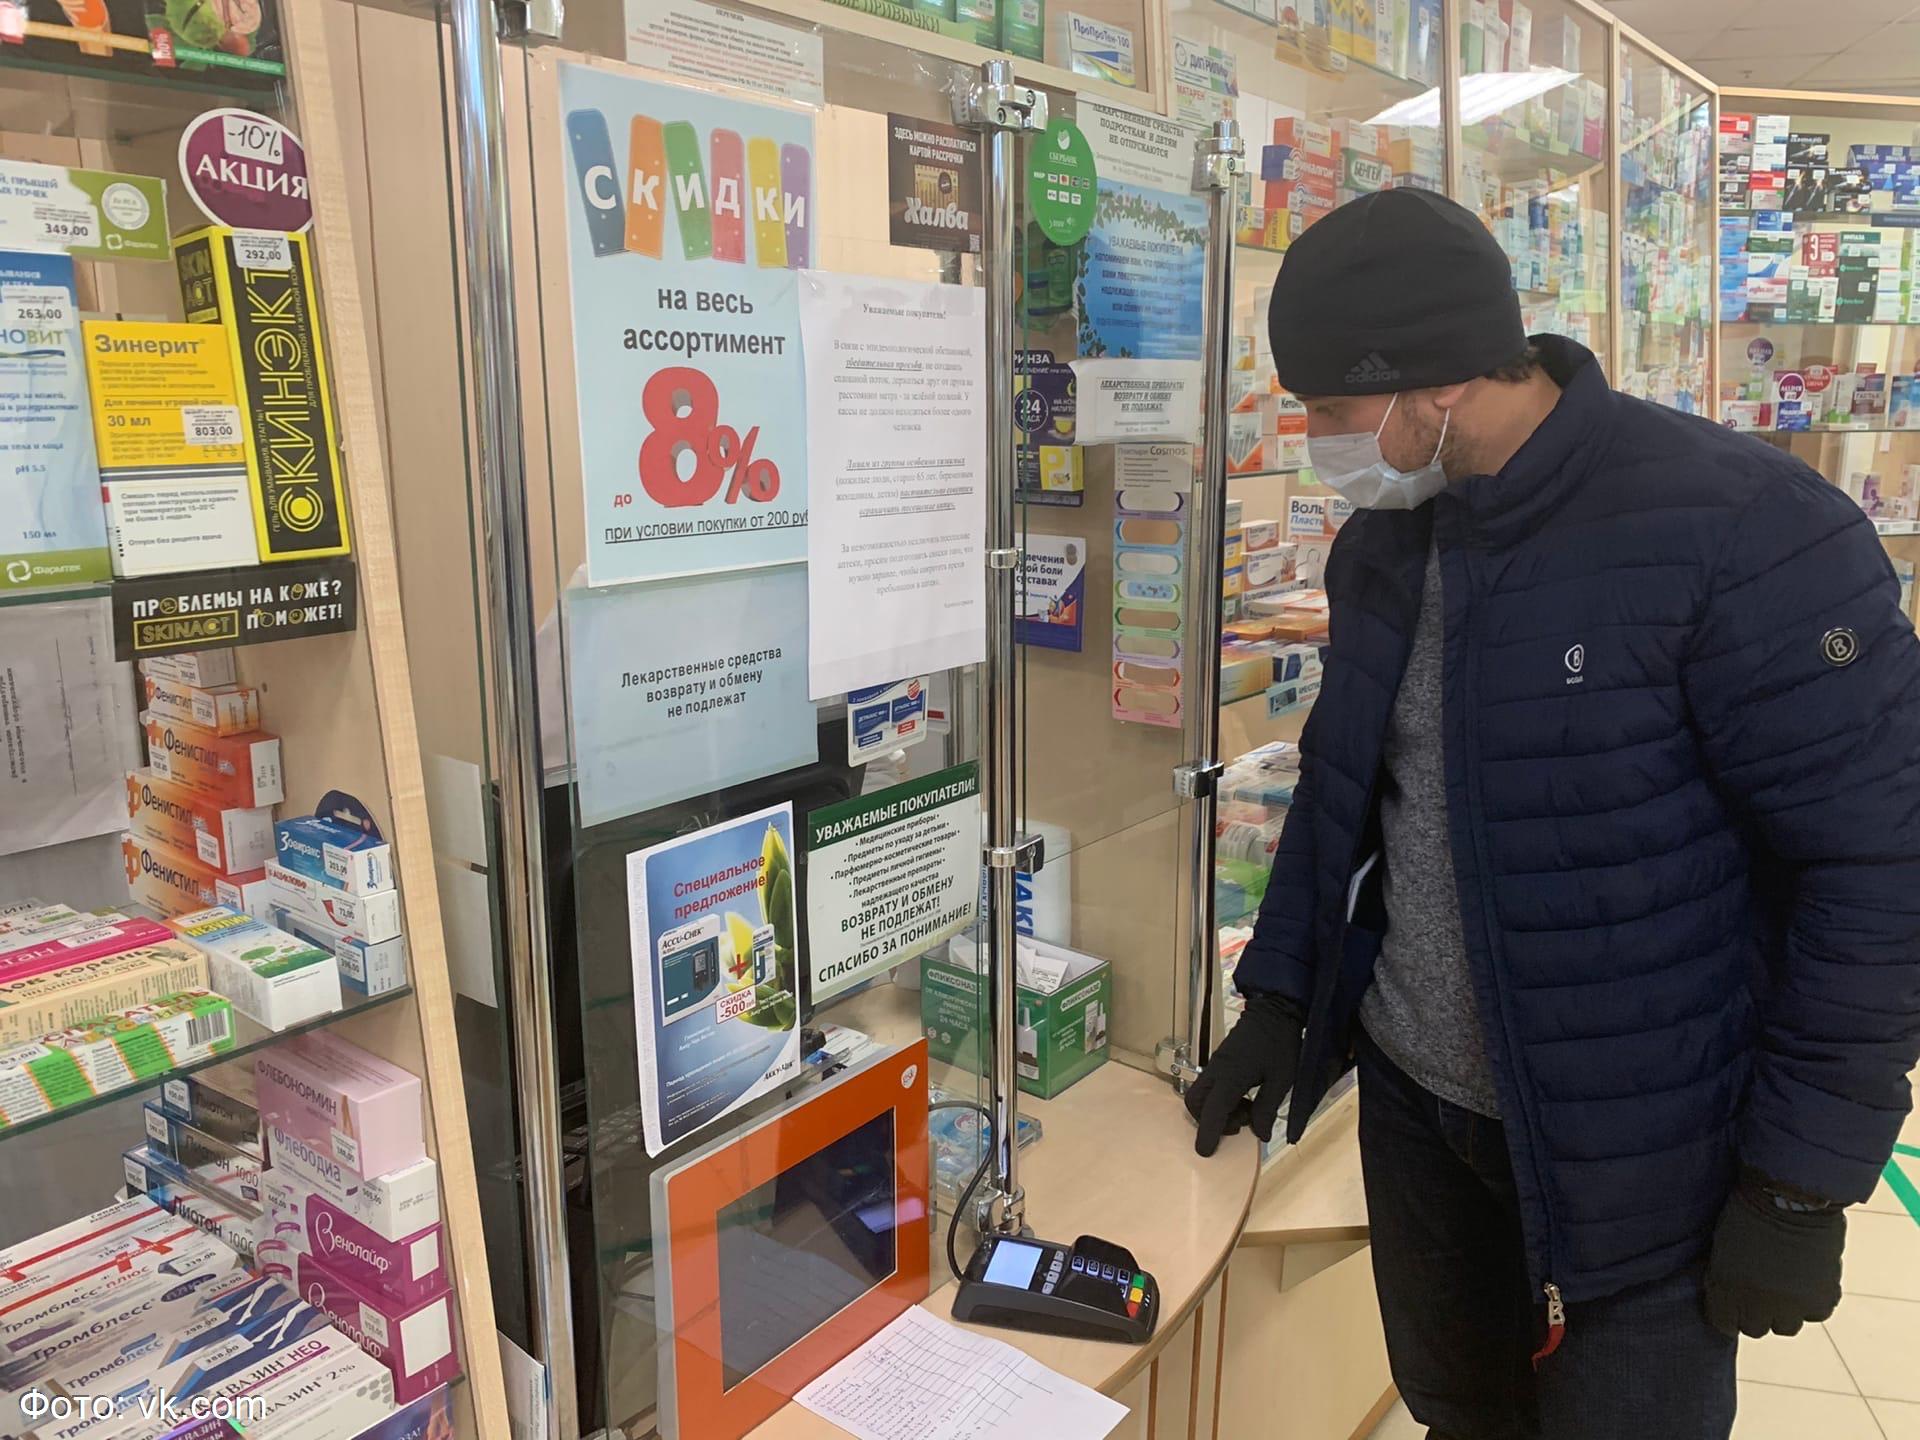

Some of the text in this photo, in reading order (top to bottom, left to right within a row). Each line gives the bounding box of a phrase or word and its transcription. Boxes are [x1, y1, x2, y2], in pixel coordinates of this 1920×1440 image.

[1100, 118, 1146, 139] ПОДРОСТКАМ
[1153, 119, 1184, 137] СРЕДСТВА
[1109, 134, 1168, 158] НЕ ОТПУСКАЮТСЯ
[196, 154, 308, 200] АКЦИЯ
[584, 165, 805, 228] СКИДКИ
[904, 197, 969, 230] Халва
[657, 287, 754, 316] на весь
[95, 334, 199, 357] Зинерит
[623, 327, 786, 360] ассортимент
[1345, 368, 1401, 384] adidas
[107, 415, 151, 427] 30 мл
[1020, 399, 1041, 415] 24
[639, 366, 781, 509] 8%
[1150, 446, 1187, 456] Cosmos
[613, 492, 633, 508] до
[605, 525, 633, 543] при
[636, 518, 694, 541] условии
[697, 513, 748, 534] покупки
[750, 512, 764, 528] от
[767, 510, 789, 527] 200
[1040, 564, 1063, 576] боли
[132, 579, 343, 618] ПРОБЛЕМЫ НА КОЖЕ?
[142, 616, 231, 643] SKINACT
[246, 603, 343, 630] ПОМОЖЕТ!
[621, 646, 782, 689] Лекарственные средства
[646, 669, 763, 704] возврату и обмену
[668, 691, 746, 718] не подлежат
[164, 728, 218, 767] Фенистил
[142, 784, 192, 825] Фенистил
[816, 777, 975, 844] УВАЖАЕМЫЕ ПОКУПАТЕЛИ!
[280, 831, 321, 858] Зовиракс
[848, 823, 946, 863] Предметы по уходу за детьми
[859, 814, 936, 847] Медицинские приборы
[141, 849, 200, 896] Фенистил
[834, 830, 957, 880] Парфюмерно-косметические товары
[853, 848, 942, 886] Предметы личной гигиены
[673, 855, 765, 899] Специальное
[674, 869, 769, 920] предложение!
[853, 860, 942, 899] Лекарственные препараты
[861, 872, 939, 908] надлежащего качества
[841, 875, 954, 932] ВОЗВРАТУ И ОБМЕНУ
[861, 896, 940, 940] НЕ ПОДЛЕЖАТ!
[818, 902, 972, 983] СПАСИБО ЗА ПОНИМАНИЕ!
[54, 949, 153, 977] корень
[720, 990, 752, 1009] СКИДКА
[720, 1001, 746, 1019] -500
[259, 1061, 337, 1116] ФЛЕБОНОРМИН
[315, 1211, 389, 1274] Венолайф
[2, 1290, 98, 1334] Тромблесс
[32, 1301, 153, 1361] Тромблесс
[66, 1340, 165, 1389] Тромблесс
[289, 1340, 323, 1362] НЕО
[327, 1363, 356, 1381] 2%
